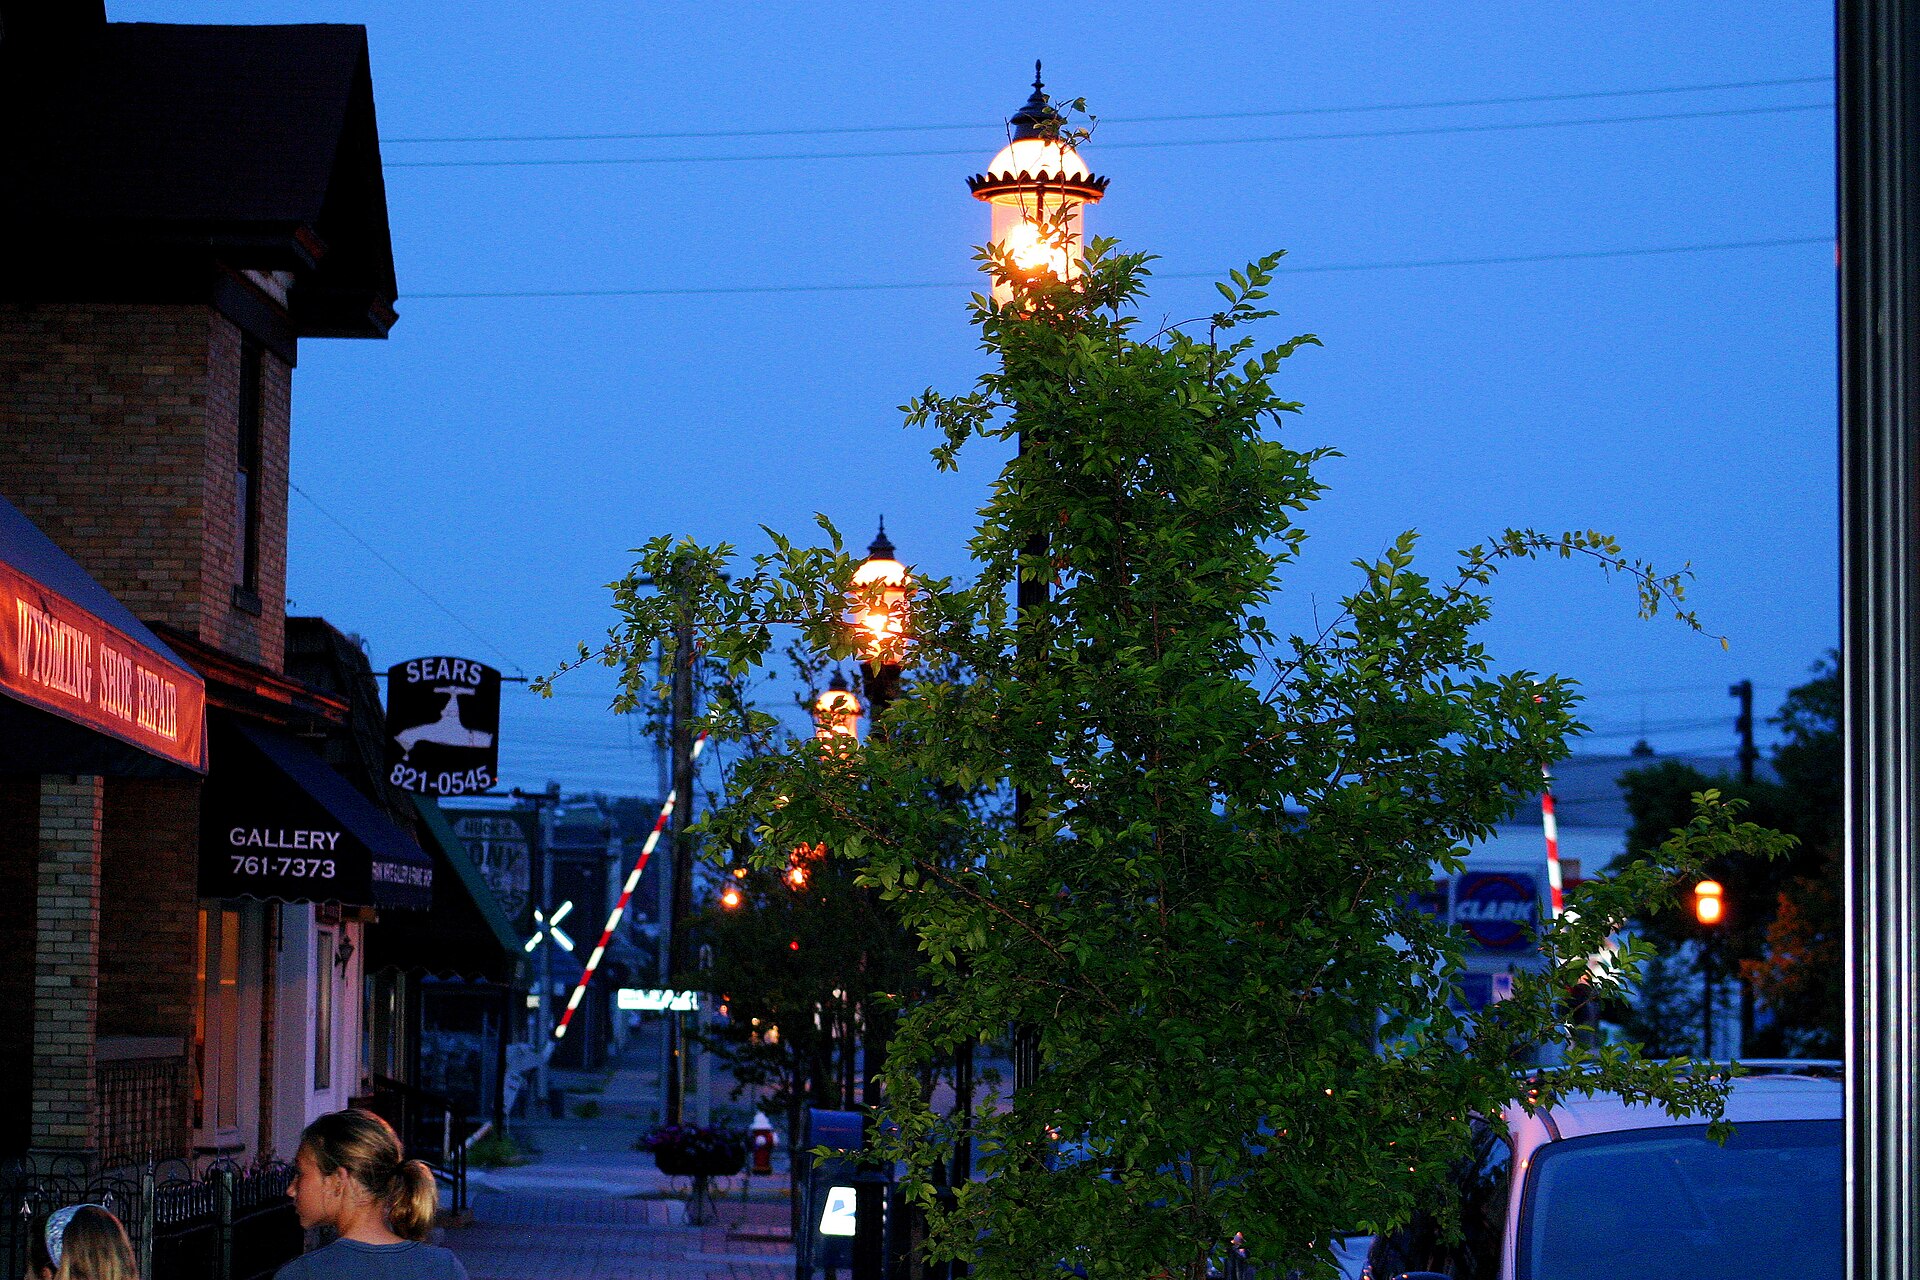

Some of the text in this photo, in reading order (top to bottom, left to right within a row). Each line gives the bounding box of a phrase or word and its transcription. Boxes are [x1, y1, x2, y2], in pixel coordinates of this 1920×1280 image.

[16, 597, 177, 742] WYOMING SHOE REPAIR
[406, 658, 482, 685] SEARS
[390, 764, 491, 795] 821-0545
[229, 827, 340, 850] GALLERY
[230, 855, 336, 878] 761-7373
[1455, 901, 1534, 920] CLARK
